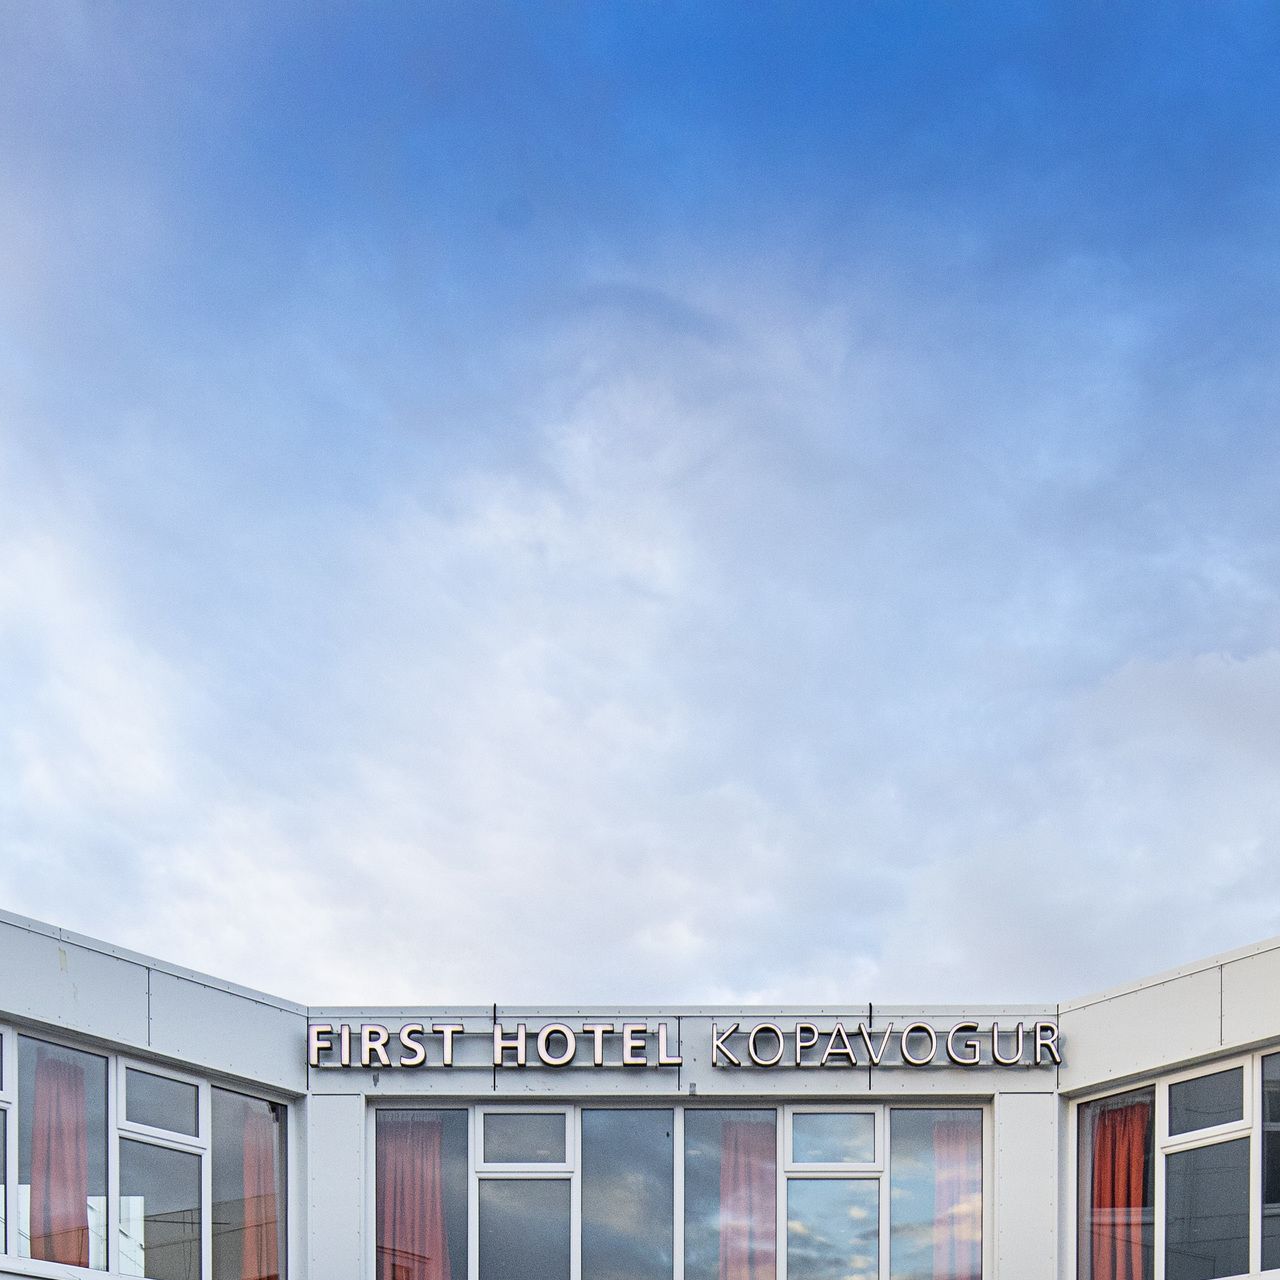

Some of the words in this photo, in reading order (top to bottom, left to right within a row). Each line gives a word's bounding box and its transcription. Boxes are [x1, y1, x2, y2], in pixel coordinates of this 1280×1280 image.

[308, 1023, 465, 1068] FIRST
[493, 1023, 683, 1068] HOTEL
[711, 1021, 1063, 1067] KOPAVOGUR
